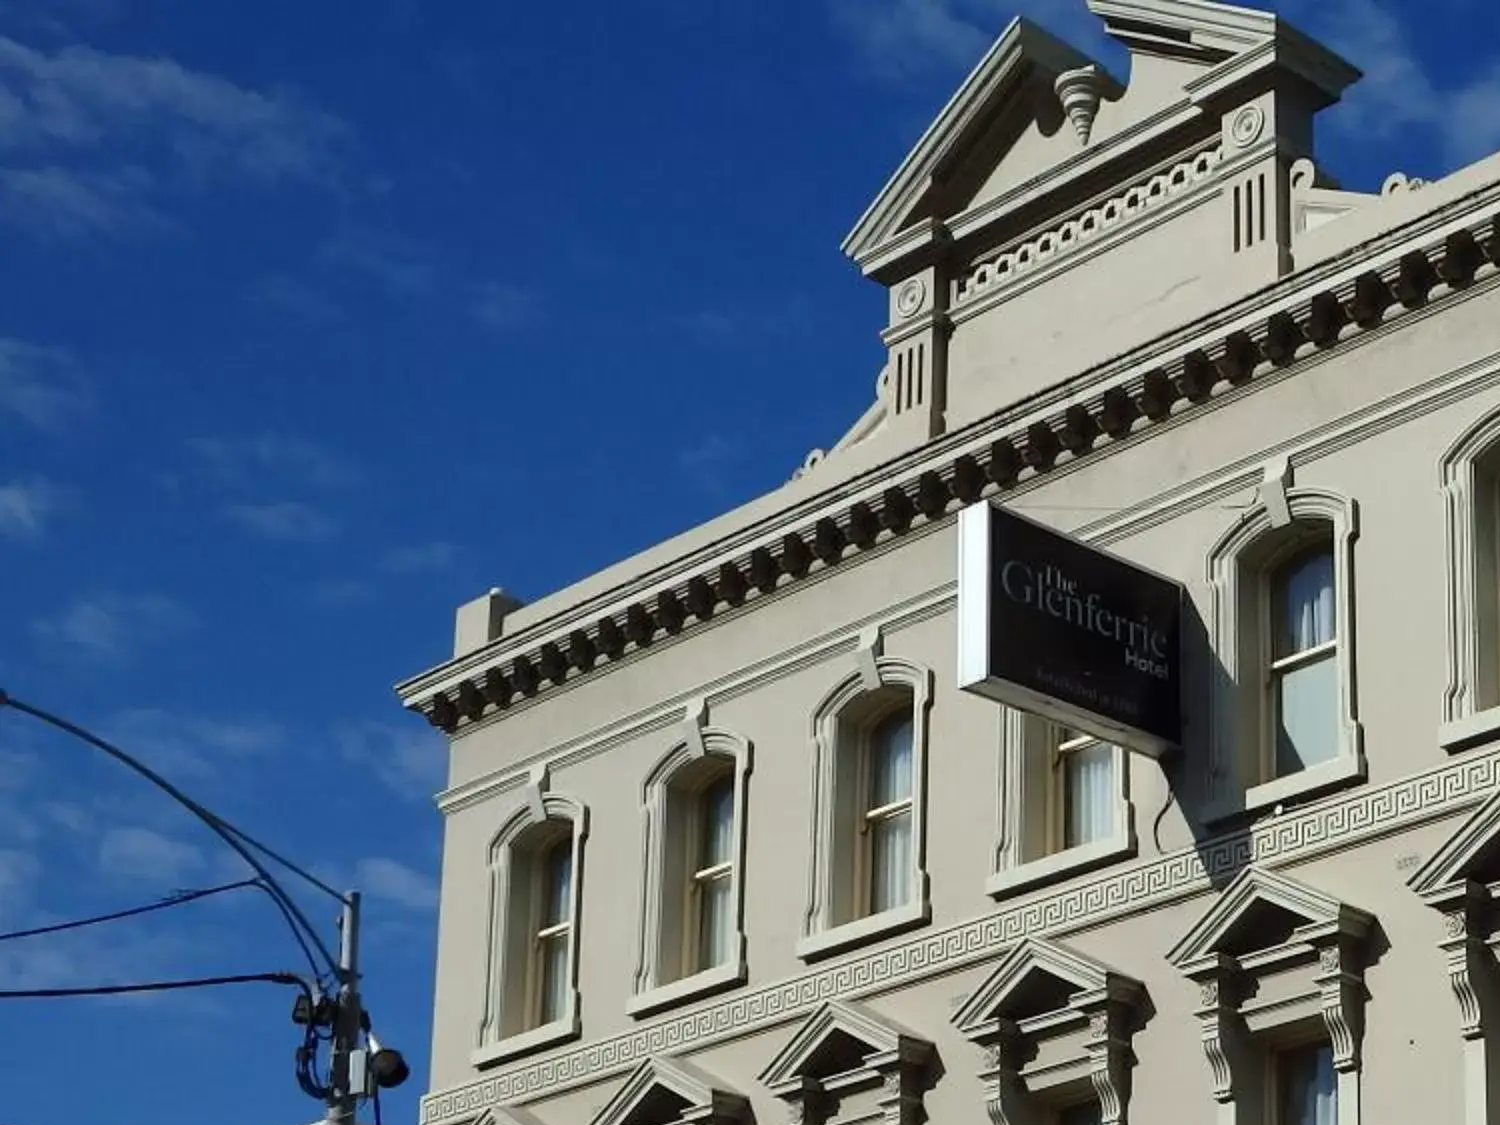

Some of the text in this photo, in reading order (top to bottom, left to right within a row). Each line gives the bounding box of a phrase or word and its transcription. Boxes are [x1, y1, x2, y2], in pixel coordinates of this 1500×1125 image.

[1042, 562, 1078, 596] The
[1002, 560, 1167, 660] Glenferrie
[1125, 645, 1171, 682] Hotel
